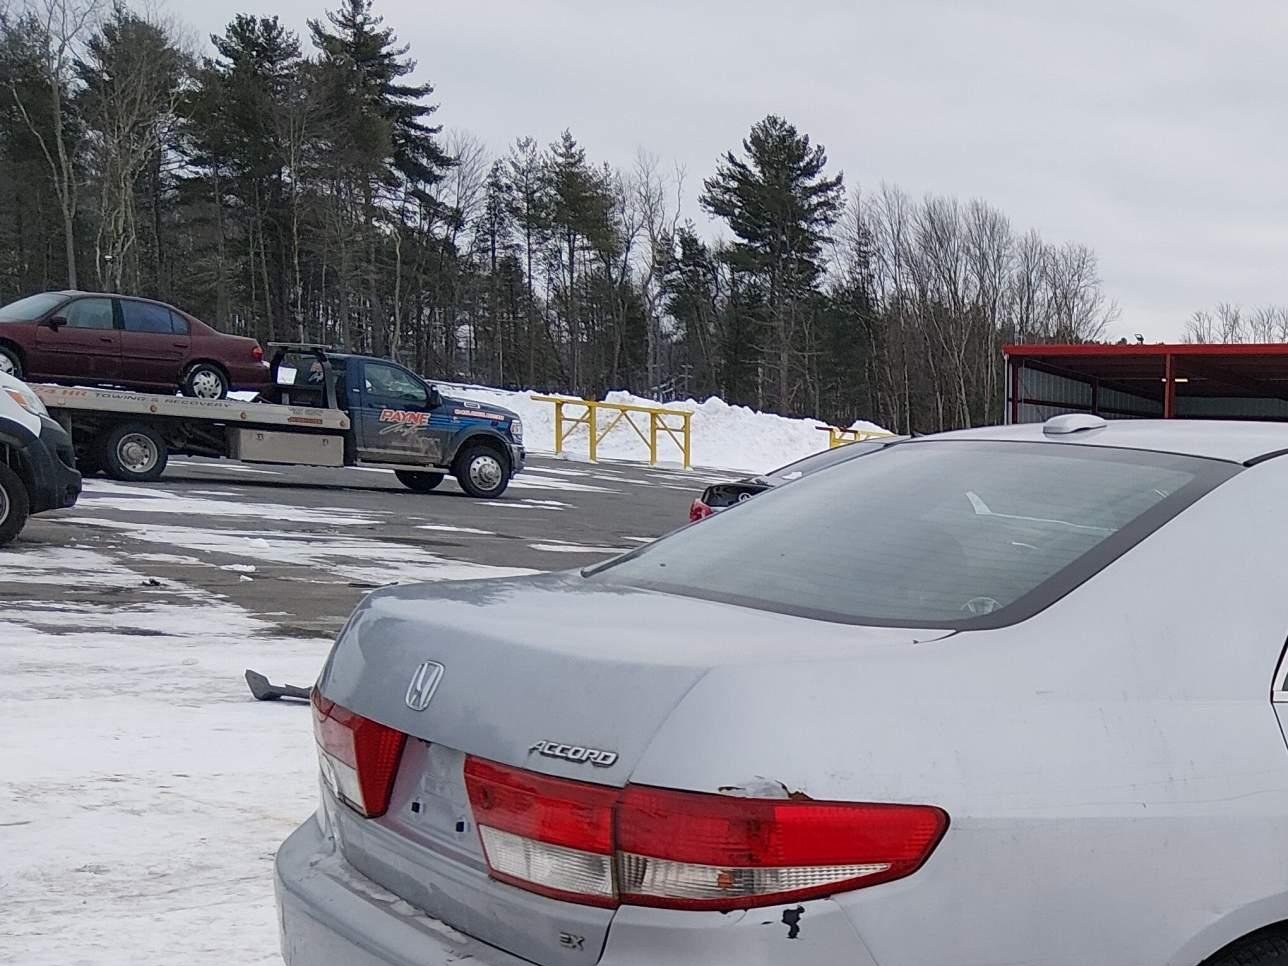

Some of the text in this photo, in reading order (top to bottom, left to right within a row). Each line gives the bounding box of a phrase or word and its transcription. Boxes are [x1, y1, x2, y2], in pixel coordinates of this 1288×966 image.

[96, 392, 146, 402] TOWING
[164, 398, 231, 409] RECOVERY
[379, 409, 432, 425] PAYNE
[528, 740, 619, 768] ACCORD
[560, 931, 585, 951] EX
